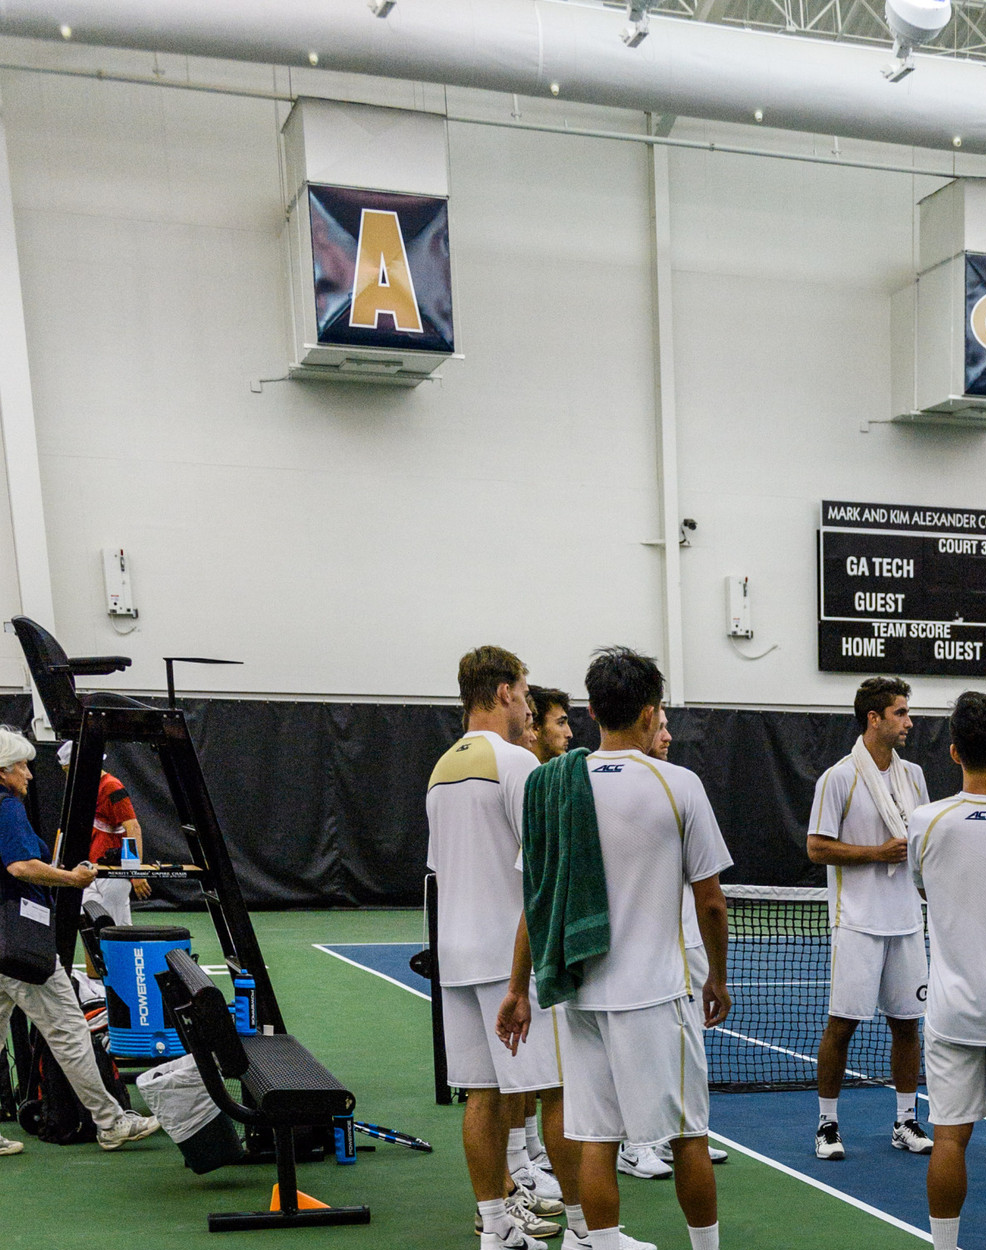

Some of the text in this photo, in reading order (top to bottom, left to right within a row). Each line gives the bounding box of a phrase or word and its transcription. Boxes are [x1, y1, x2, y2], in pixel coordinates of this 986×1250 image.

[349, 208, 424, 333] A
[827, 505, 860, 522] MARK
[862, 508, 888, 523] AND
[890, 510, 911, 525] KIM
[913, 511, 976, 528] ALEXANDER
[938, 538, 978, 555] COURT
[846, 556, 914, 579] GA TECH
[854, 592, 905, 613] GUEST
[872, 622, 951, 639] TEAM SCORE
[842, 637, 983, 660] HOME GUEST
[591, 764, 625, 773] ACC
[133, 947, 150, 1026] POWERADE
